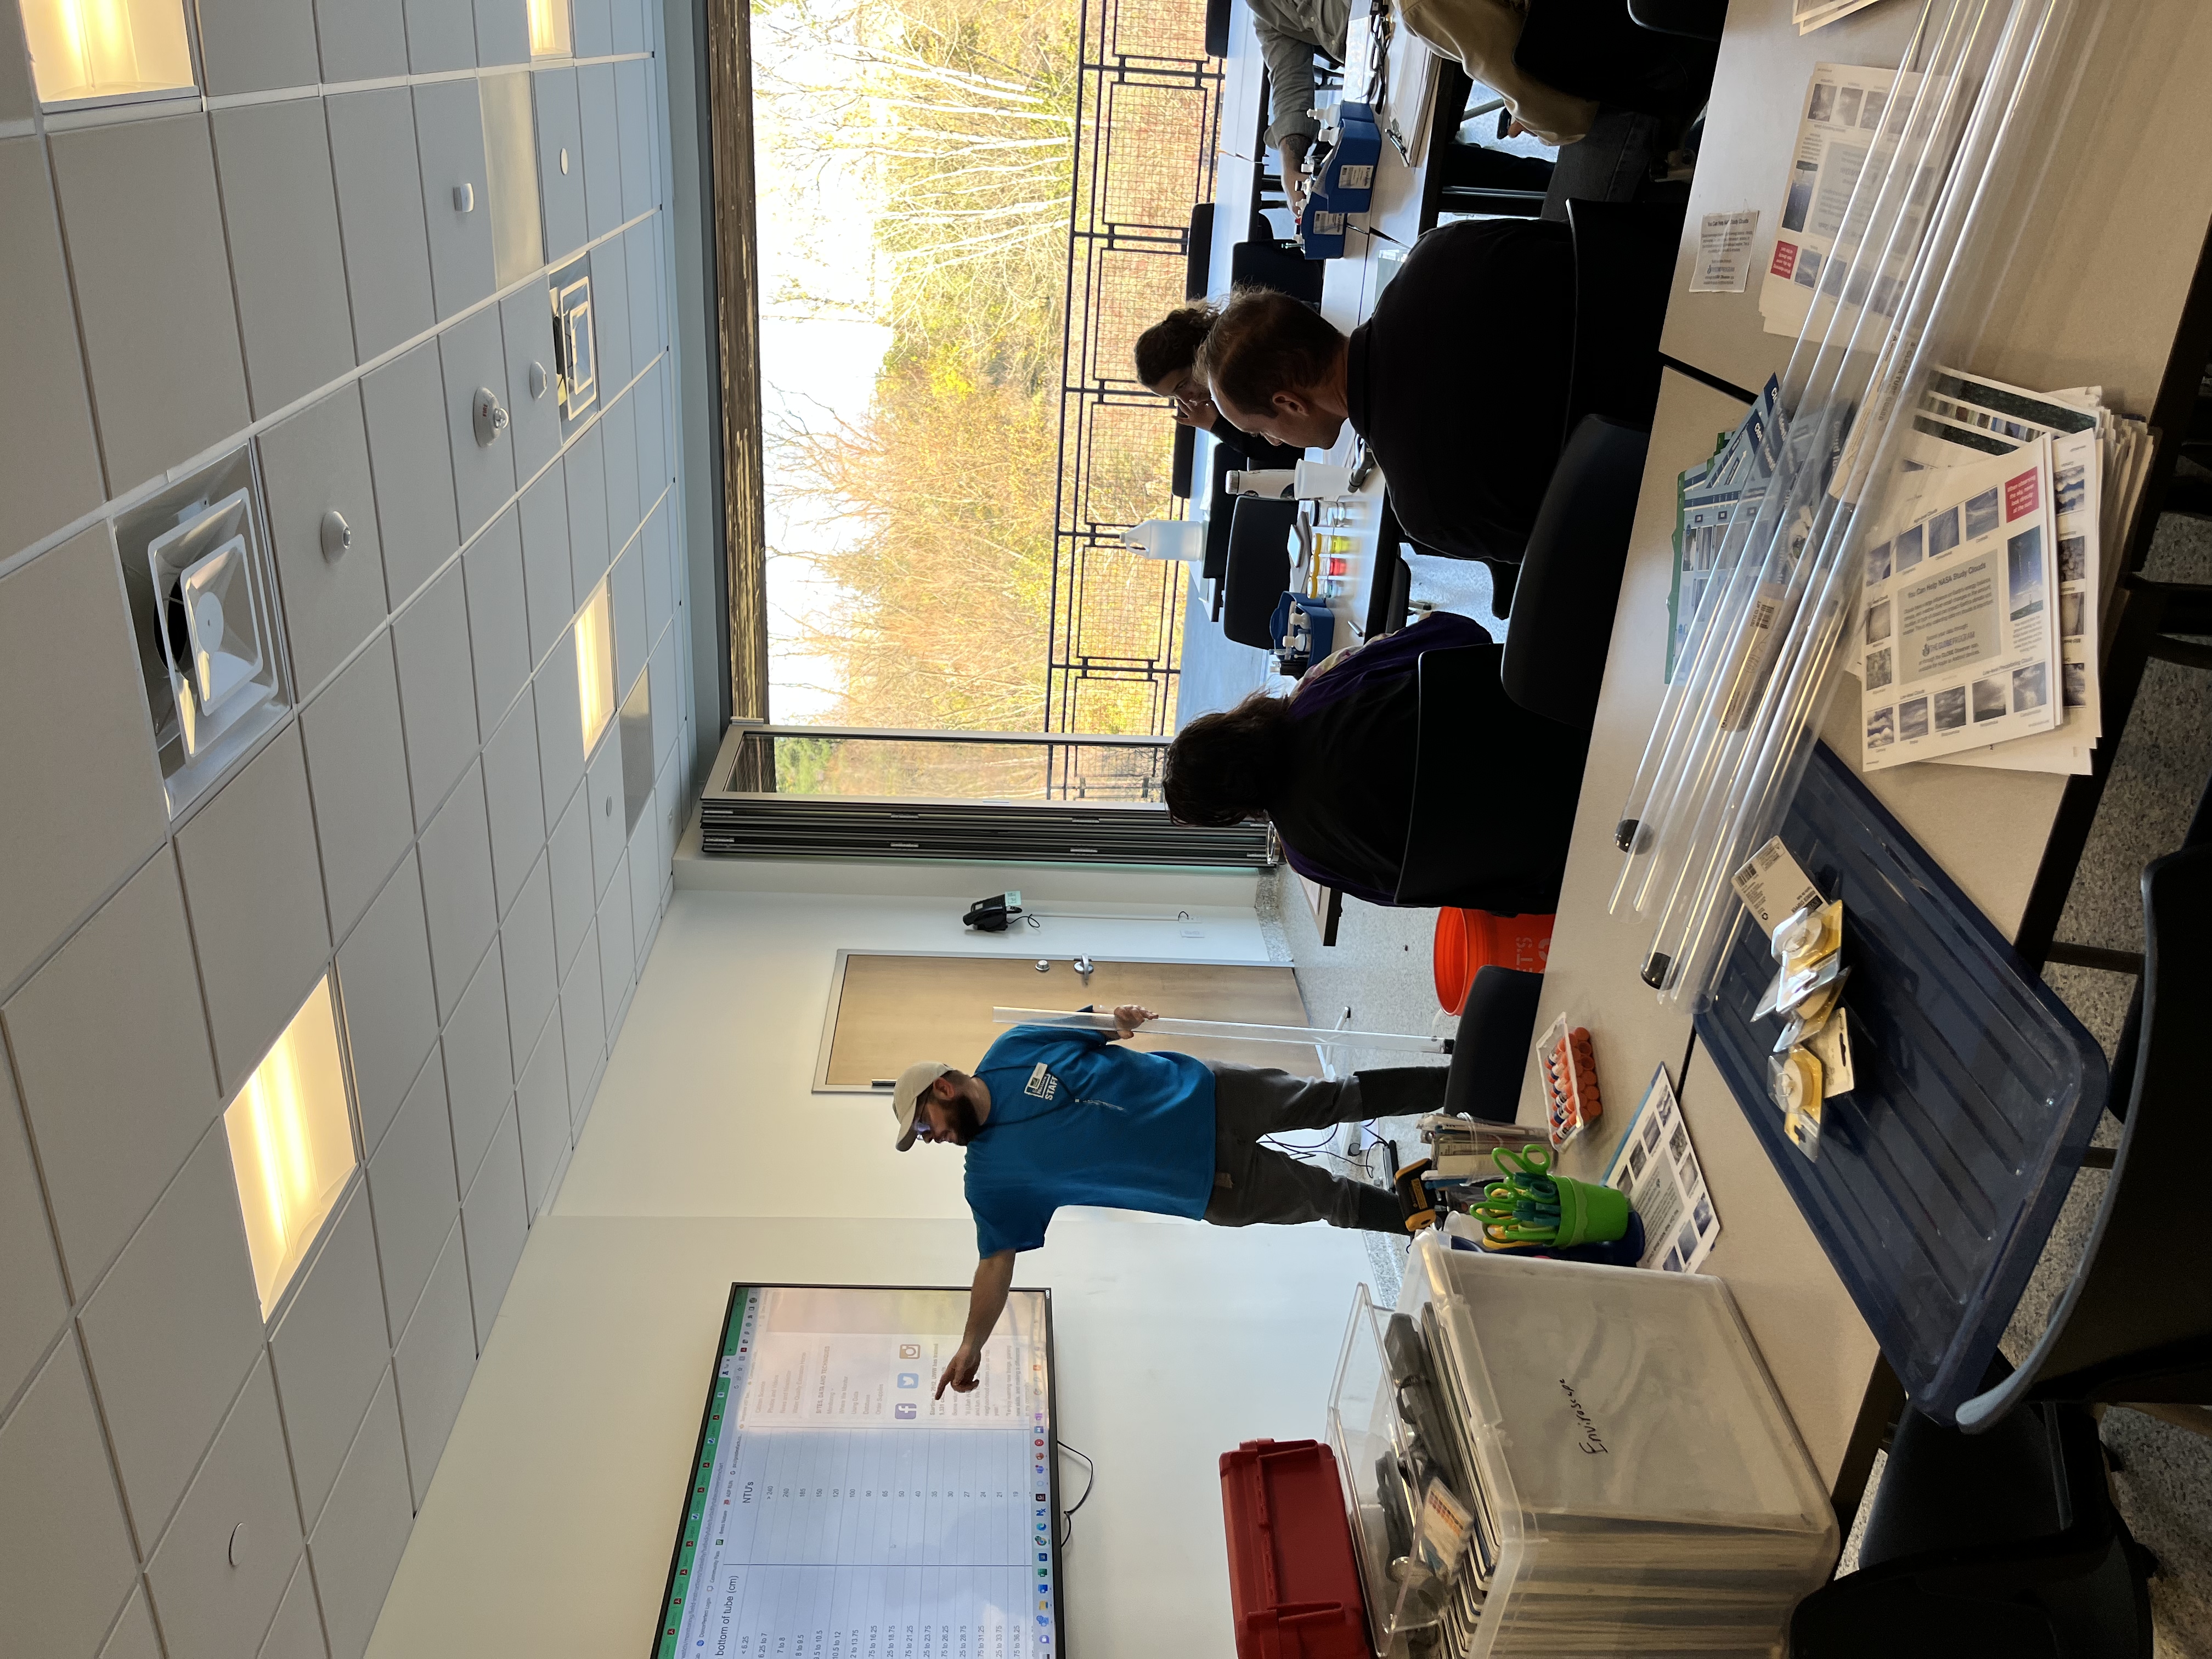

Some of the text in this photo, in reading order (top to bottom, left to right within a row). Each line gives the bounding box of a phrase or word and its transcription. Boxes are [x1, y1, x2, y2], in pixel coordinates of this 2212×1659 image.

[1916, 587, 1926, 596] Can
[1938, 575, 1953, 586] NASA
[1953, 570, 1967, 581] Study
[1968, 562, 1987, 574] Clouds
[1952, 631, 1976, 645] PROGRAM
[1045, 1075, 1058, 1101] STAFF
[821, 1346, 830, 1374] TECHNIQUES
[783, 1370, 792, 1392] Newsletter
[796, 1365, 805, 1385] Extension
[755, 1381, 766, 1413] Citizen Science
[793, 1386, 803, 1400] Quality
[827, 1392, 836, 1414] Monitoring
[850, 1402, 859, 1414] Using
[742, 1481, 754, 1503] NTU's
[715, 1575, 739, 1655] bottom of tube (cm)
[741, 1636, 749, 1649] 6.25
[815, 1630, 823, 1643] 10.5
